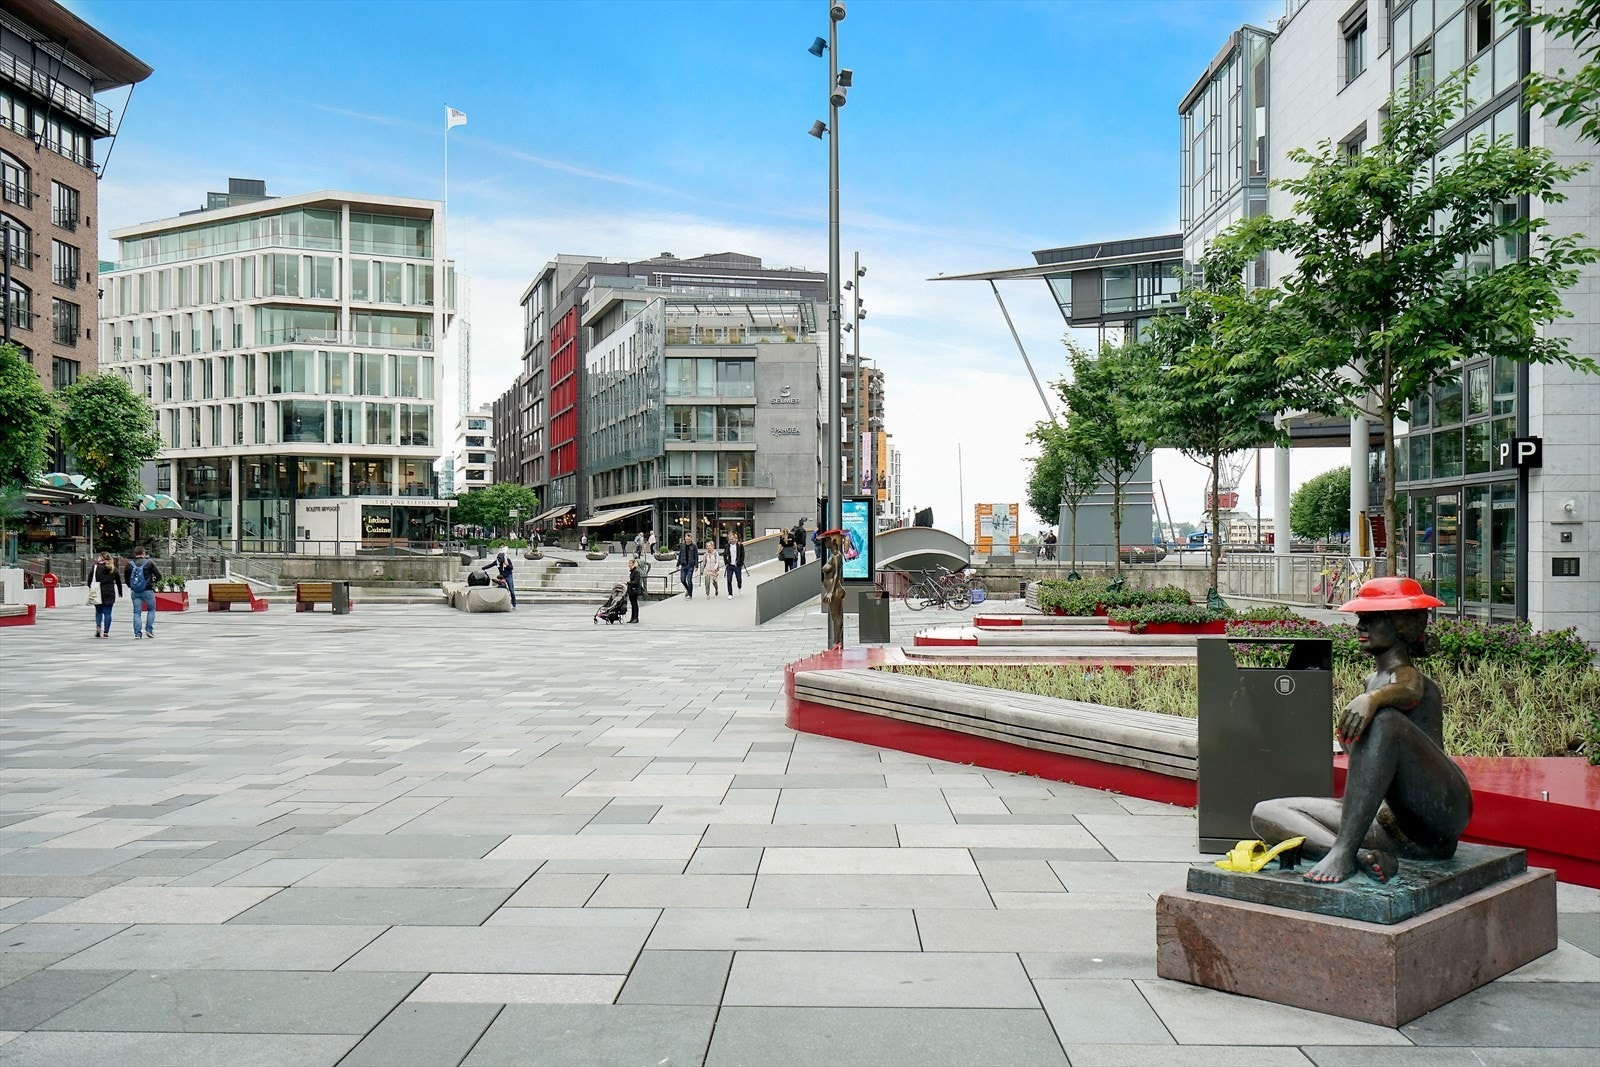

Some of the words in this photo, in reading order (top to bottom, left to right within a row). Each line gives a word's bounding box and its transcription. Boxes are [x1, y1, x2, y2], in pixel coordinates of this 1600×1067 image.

[1500, 442, 1510, 466] P
[1517, 441, 1537, 465] P
[368, 516, 389, 524] Indian
[365, 525, 392, 533] Cuisine
